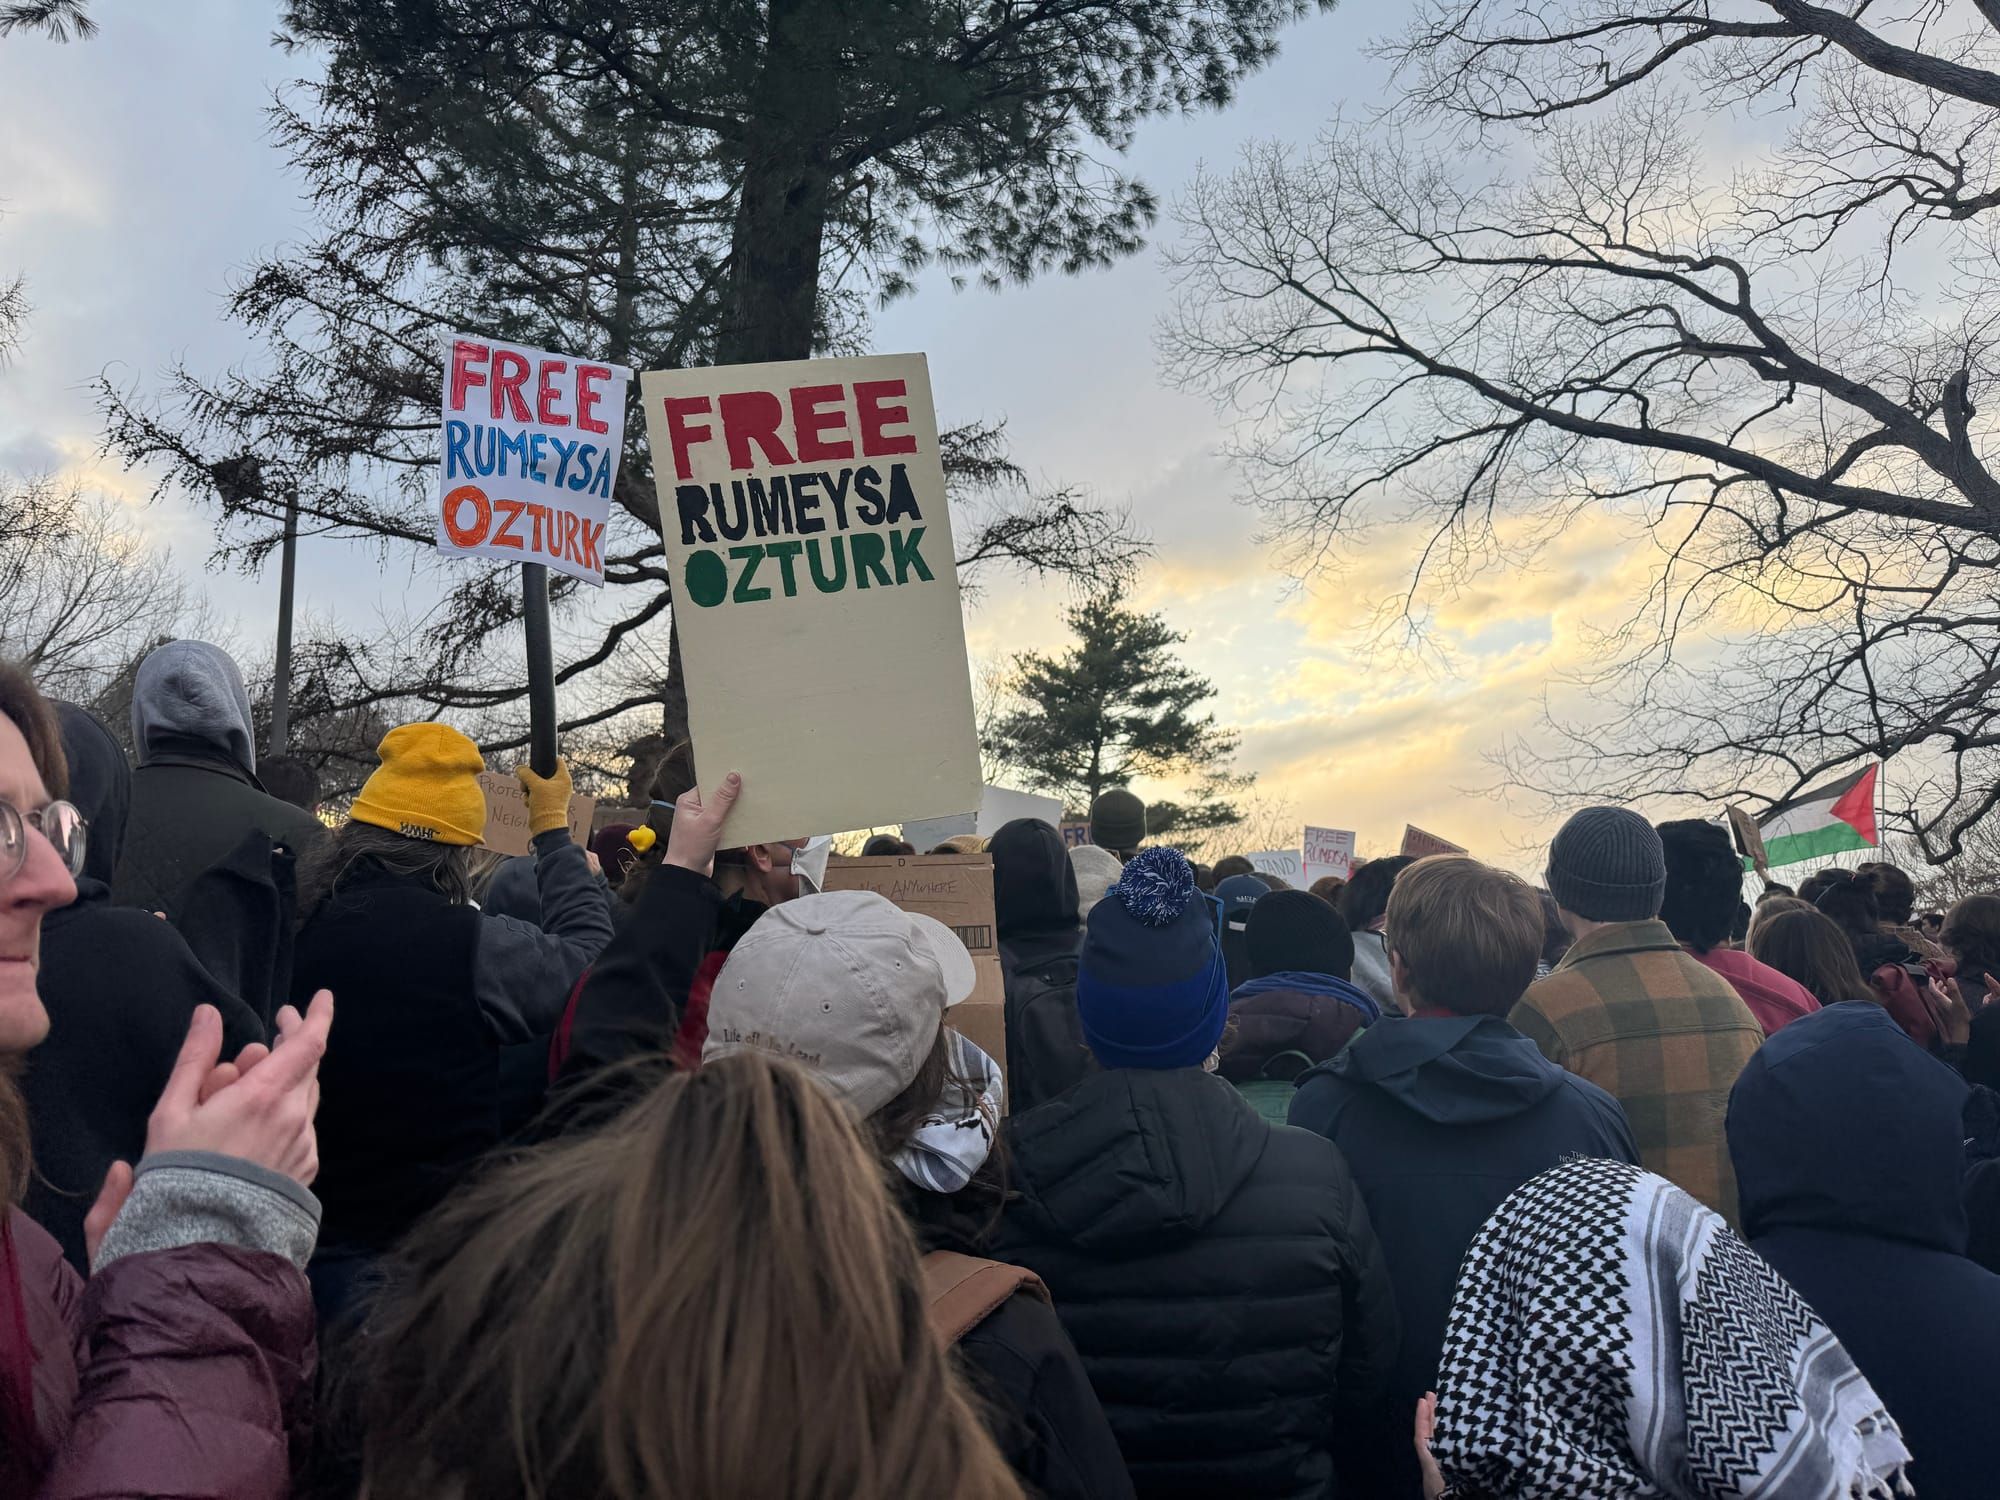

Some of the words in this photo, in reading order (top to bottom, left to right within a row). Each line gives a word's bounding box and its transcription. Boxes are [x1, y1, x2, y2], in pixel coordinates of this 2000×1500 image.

[449, 339, 612, 435] FREE
[664, 379, 918, 481] FREE
[446, 420, 612, 498] RUMEYSA
[442, 485, 605, 575] OZTURK
[675, 463, 923, 546] RUMEYSA
[685, 526, 935, 608] OZTURK
